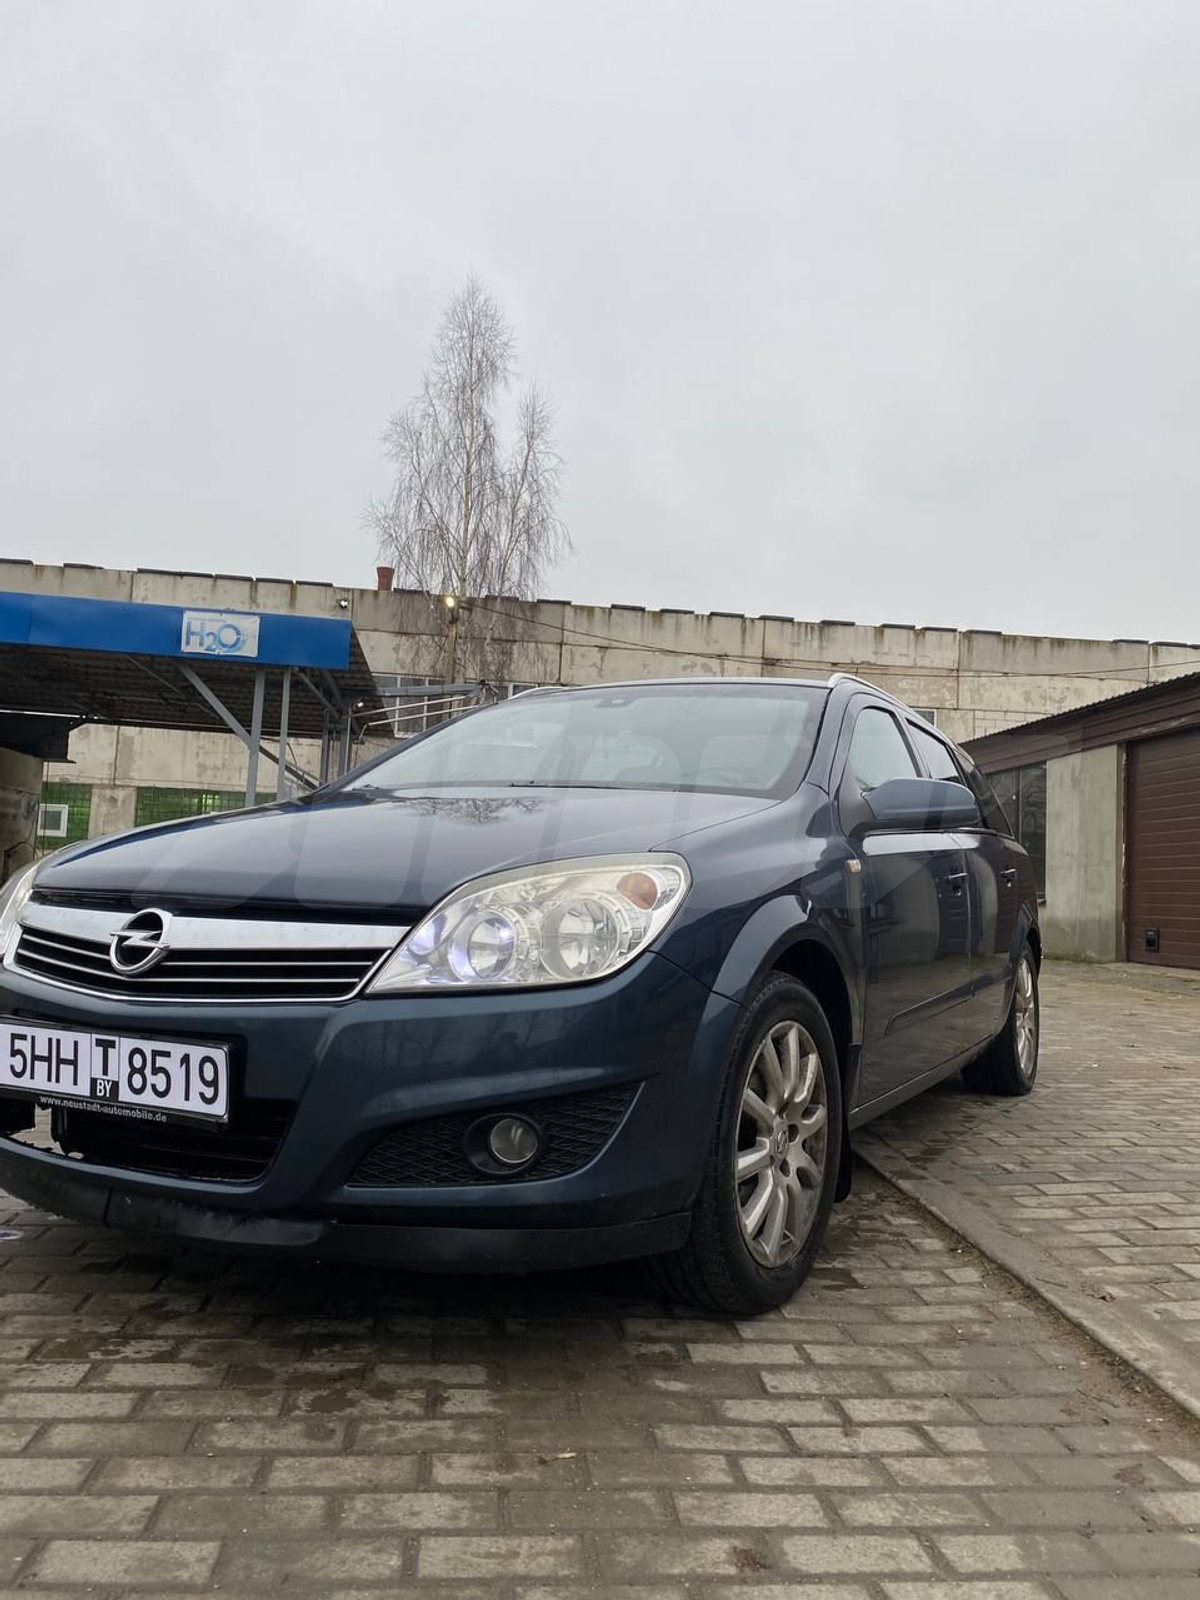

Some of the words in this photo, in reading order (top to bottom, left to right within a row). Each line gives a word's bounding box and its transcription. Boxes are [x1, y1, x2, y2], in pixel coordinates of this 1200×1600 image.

[9, 1032, 79, 1087] 5HH
[95, 1038, 117, 1077] T
[127, 1047, 219, 1105] 8519
[96, 1079, 114, 1098] BY
[39, 1095, 168, 1123] www.neustadt-automobile.de
